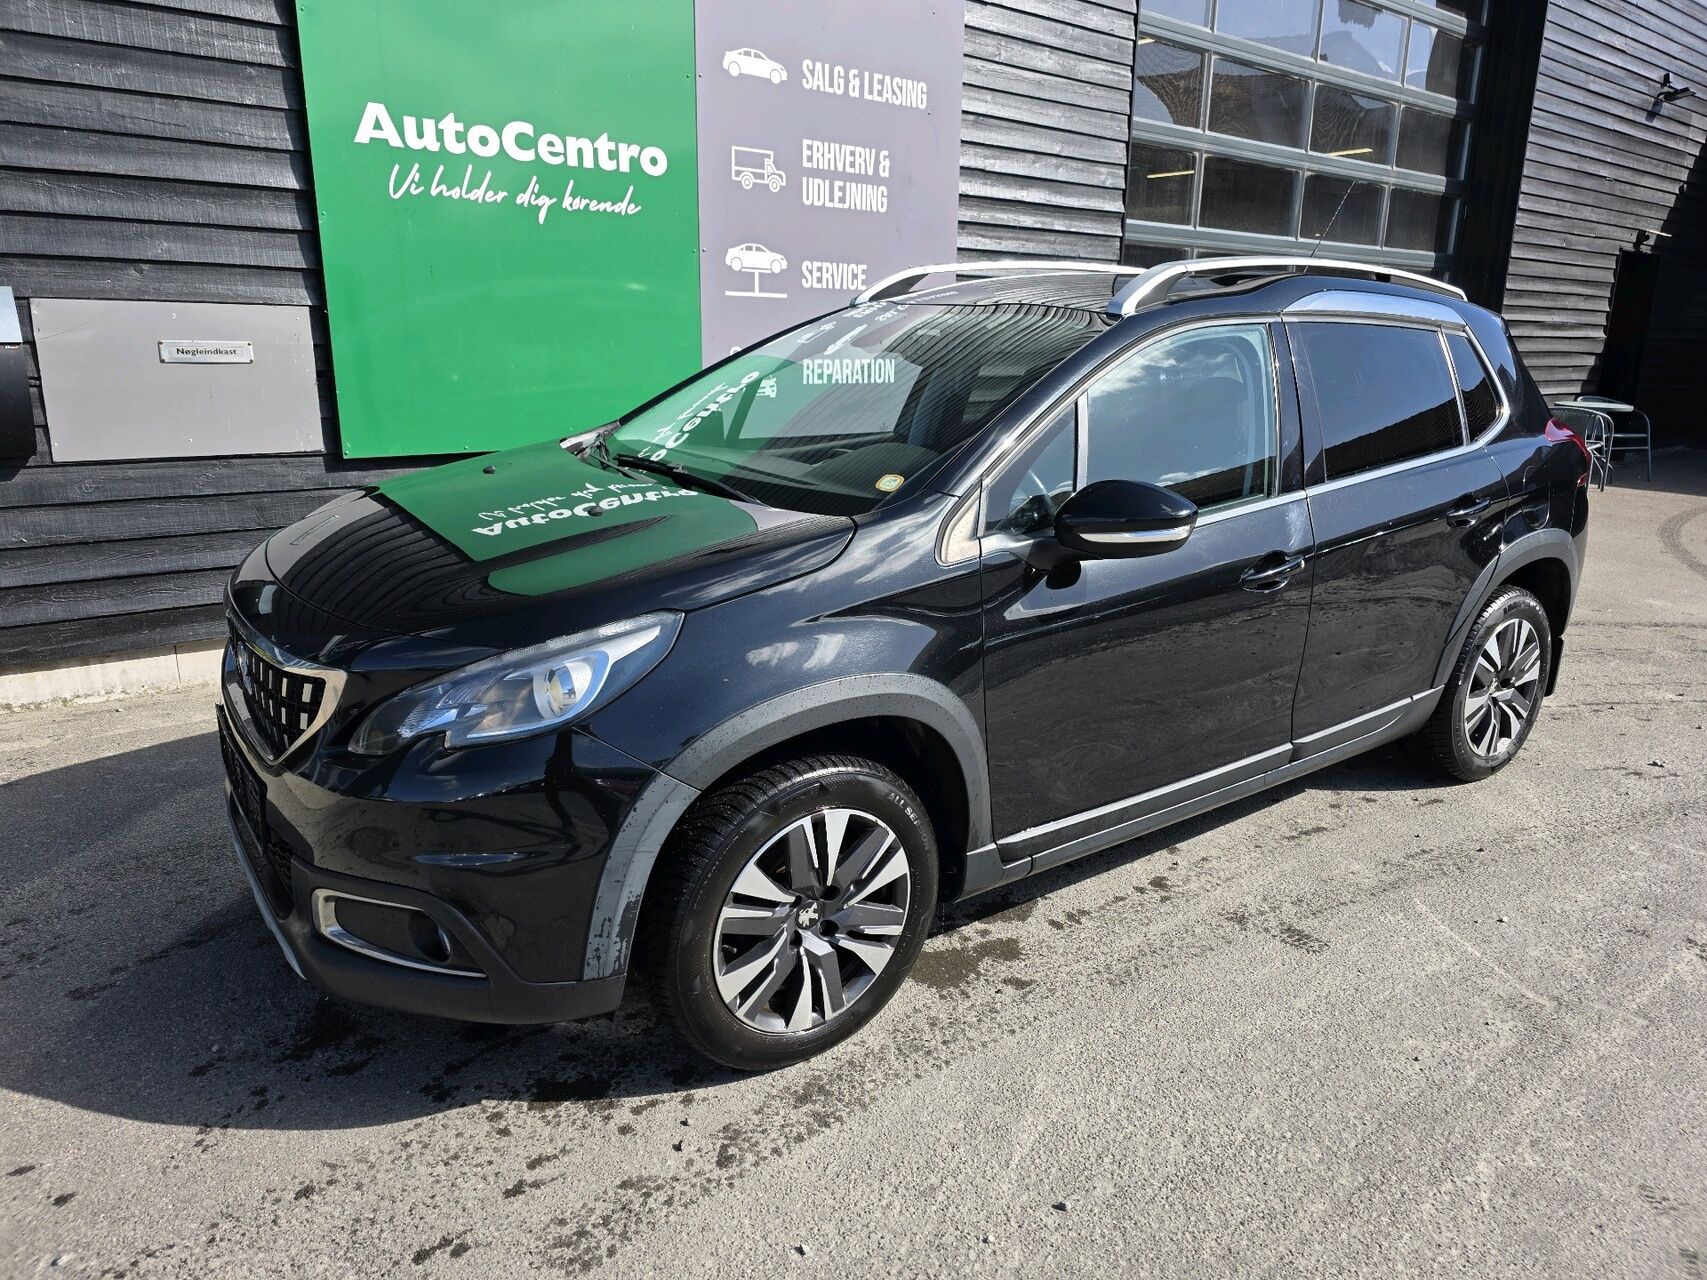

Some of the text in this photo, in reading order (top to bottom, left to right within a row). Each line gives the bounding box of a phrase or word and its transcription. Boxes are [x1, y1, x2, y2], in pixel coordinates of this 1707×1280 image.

[802, 59, 926, 109] SALG & LEASING
[354, 101, 668, 177] AutoCentro
[802, 138, 890, 178] ERHVERV &
[388, 163, 642, 225] Vi holder dig kørende
[802, 177, 888, 213] UDLEJNING
[801, 260, 868, 291] SERVICE
[176, 347, 237, 356] Nøgleindkast
[802, 358, 896, 385] REPARATION
